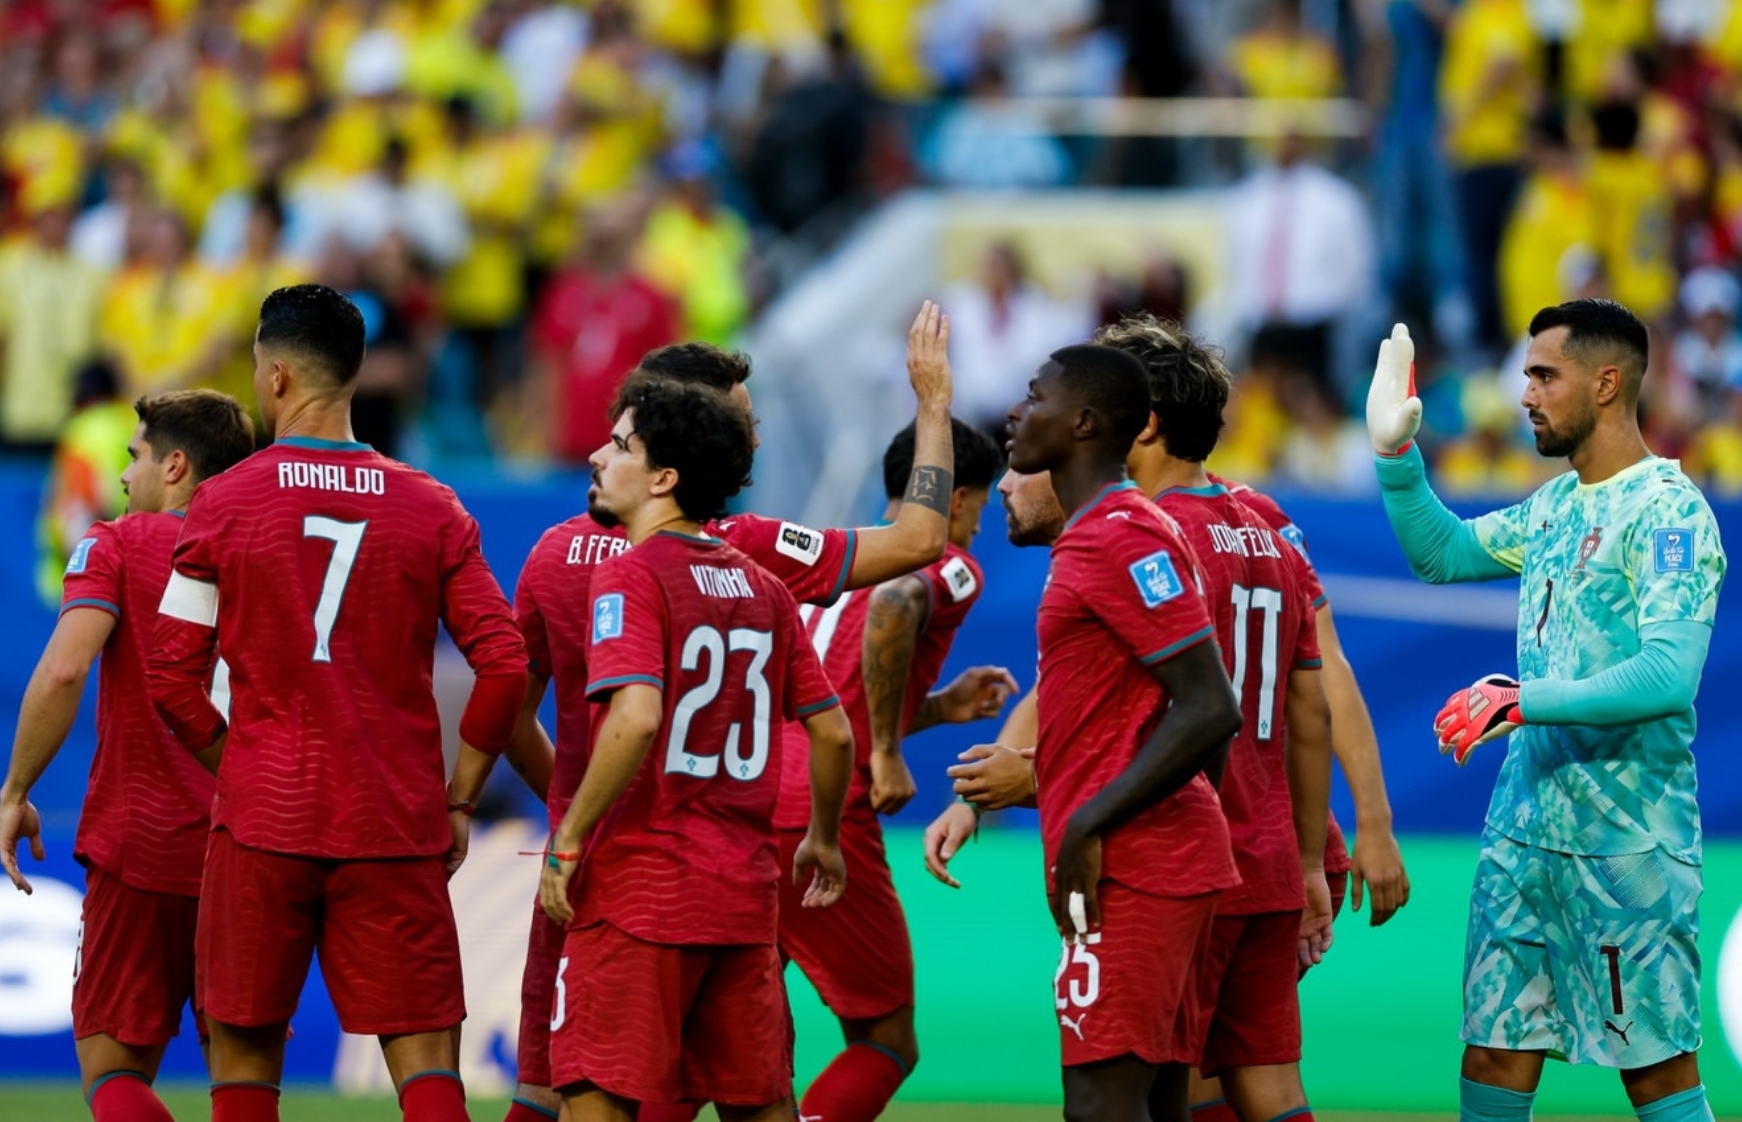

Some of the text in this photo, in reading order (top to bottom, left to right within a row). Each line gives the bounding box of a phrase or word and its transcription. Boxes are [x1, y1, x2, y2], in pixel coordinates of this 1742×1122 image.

[278, 462, 385, 495] RONALDO
[303, 515, 369, 662] 7
[689, 564, 755, 598] VITINHA
[664, 624, 773, 781] 23
[1600, 945, 1623, 1015] 1
